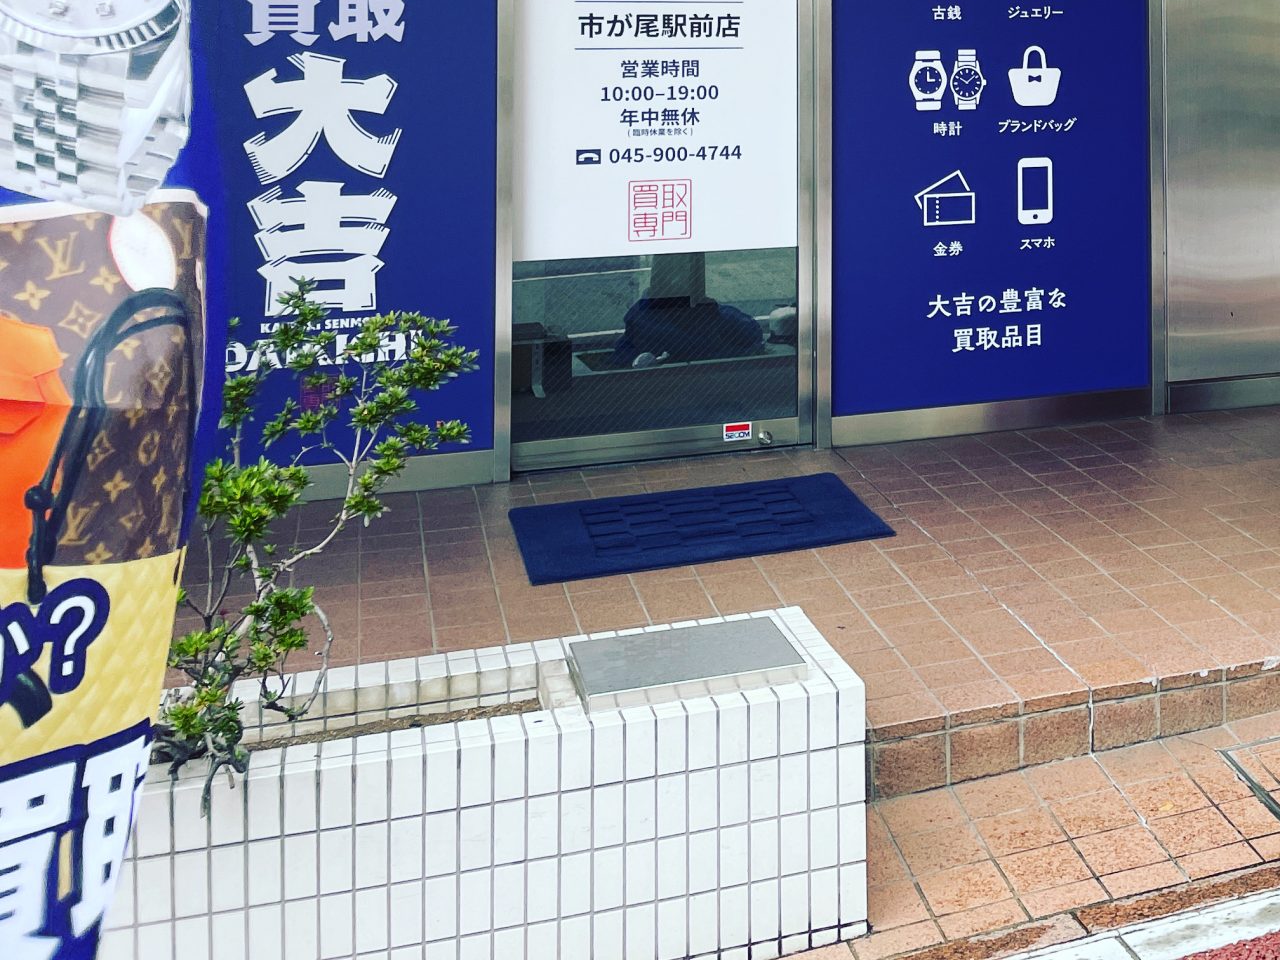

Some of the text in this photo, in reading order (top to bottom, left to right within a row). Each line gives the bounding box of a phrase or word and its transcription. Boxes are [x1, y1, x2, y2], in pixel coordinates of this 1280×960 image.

[932, 5, 962, 21] 古銭
[1007, 6, 1064, 20] ジュエリー
[578, 13, 741, 39] 市が尾駅前店
[620, 59, 700, 79] 営業時間
[620, 107, 700, 127] 年中無休
[998, 117, 1077, 133] ブランドバッグ
[933, 121, 962, 136] 時計
[609, 145, 742, 164] 045-900-4744
[243, 51, 403, 317] 大吉
[632, 183, 688, 210] 買取
[632, 211, 688, 238] 専門
[933, 241, 963, 257] 金券
[1019, 236, 1056, 250] スマホ
[926, 286, 1067, 319] 大吉の豊富な
[951, 323, 1043, 353] 買取品目
[725, 430, 751, 440] SECOM
